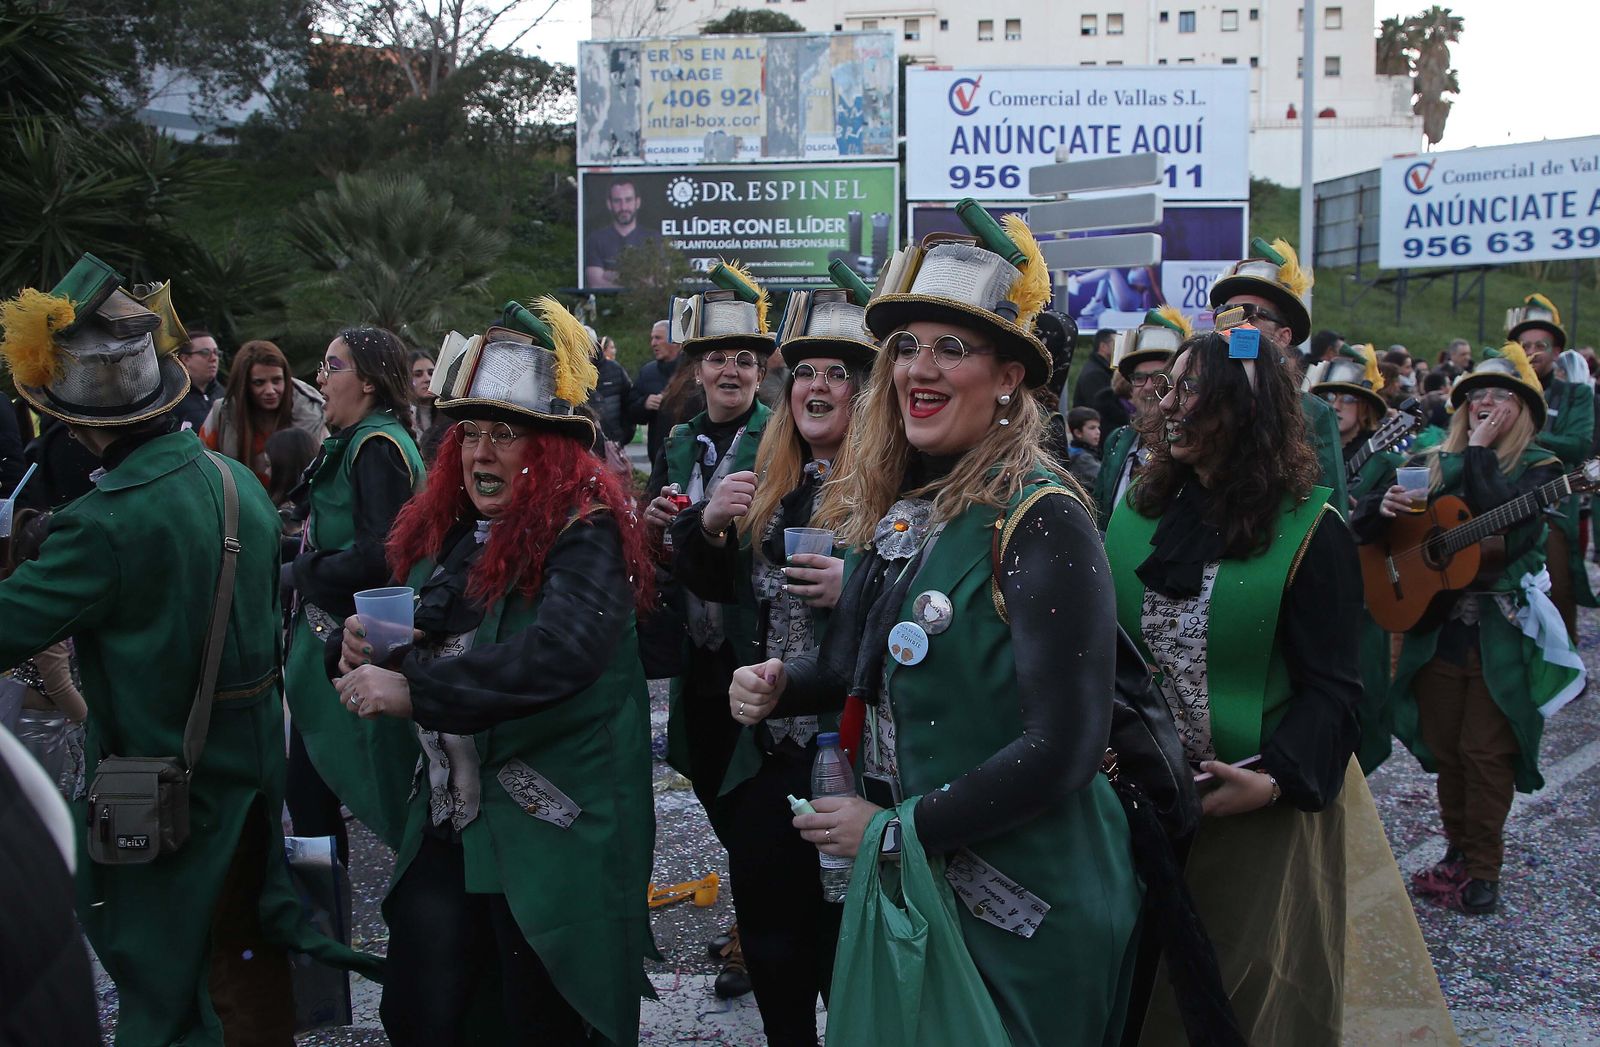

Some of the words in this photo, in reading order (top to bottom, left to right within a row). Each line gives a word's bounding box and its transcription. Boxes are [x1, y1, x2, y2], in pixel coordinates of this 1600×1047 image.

[702, 48, 726, 60] EN
[663, 88, 711, 108] 406
[989, 89, 1083, 106] Comercial
[1087, 89, 1106, 106] de
[1114, 89, 1167, 106] Vallas
[1173, 91, 1206, 106] S.L.
[950, 117, 1121, 154] ANÚNCIATE
[1131, 117, 1204, 154] AQUÍ
[949, 164, 1021, 189] 956
[1164, 164, 1204, 188] 11
[1442, 162, 1534, 185] Comercial
[1541, 160, 1564, 176] de
[702, 181, 743, 201] DR.
[748, 179, 867, 200] ESPINEL
[1405, 191, 1577, 229] ANÚNCIATE
[662, 219, 681, 235] EL
[683, 216, 731, 235] LÍDER
[733, 219, 772, 234] CON
[775, 219, 794, 234] EL
[797, 215, 846, 233] LÍDER
[743, 239, 778, 249] DENTAL
[780, 238, 846, 248] RESPONSABLE
[1403, 234, 1472, 259] 956
[1487, 230, 1534, 253] 63
[1551, 226, 1600, 250] 39
